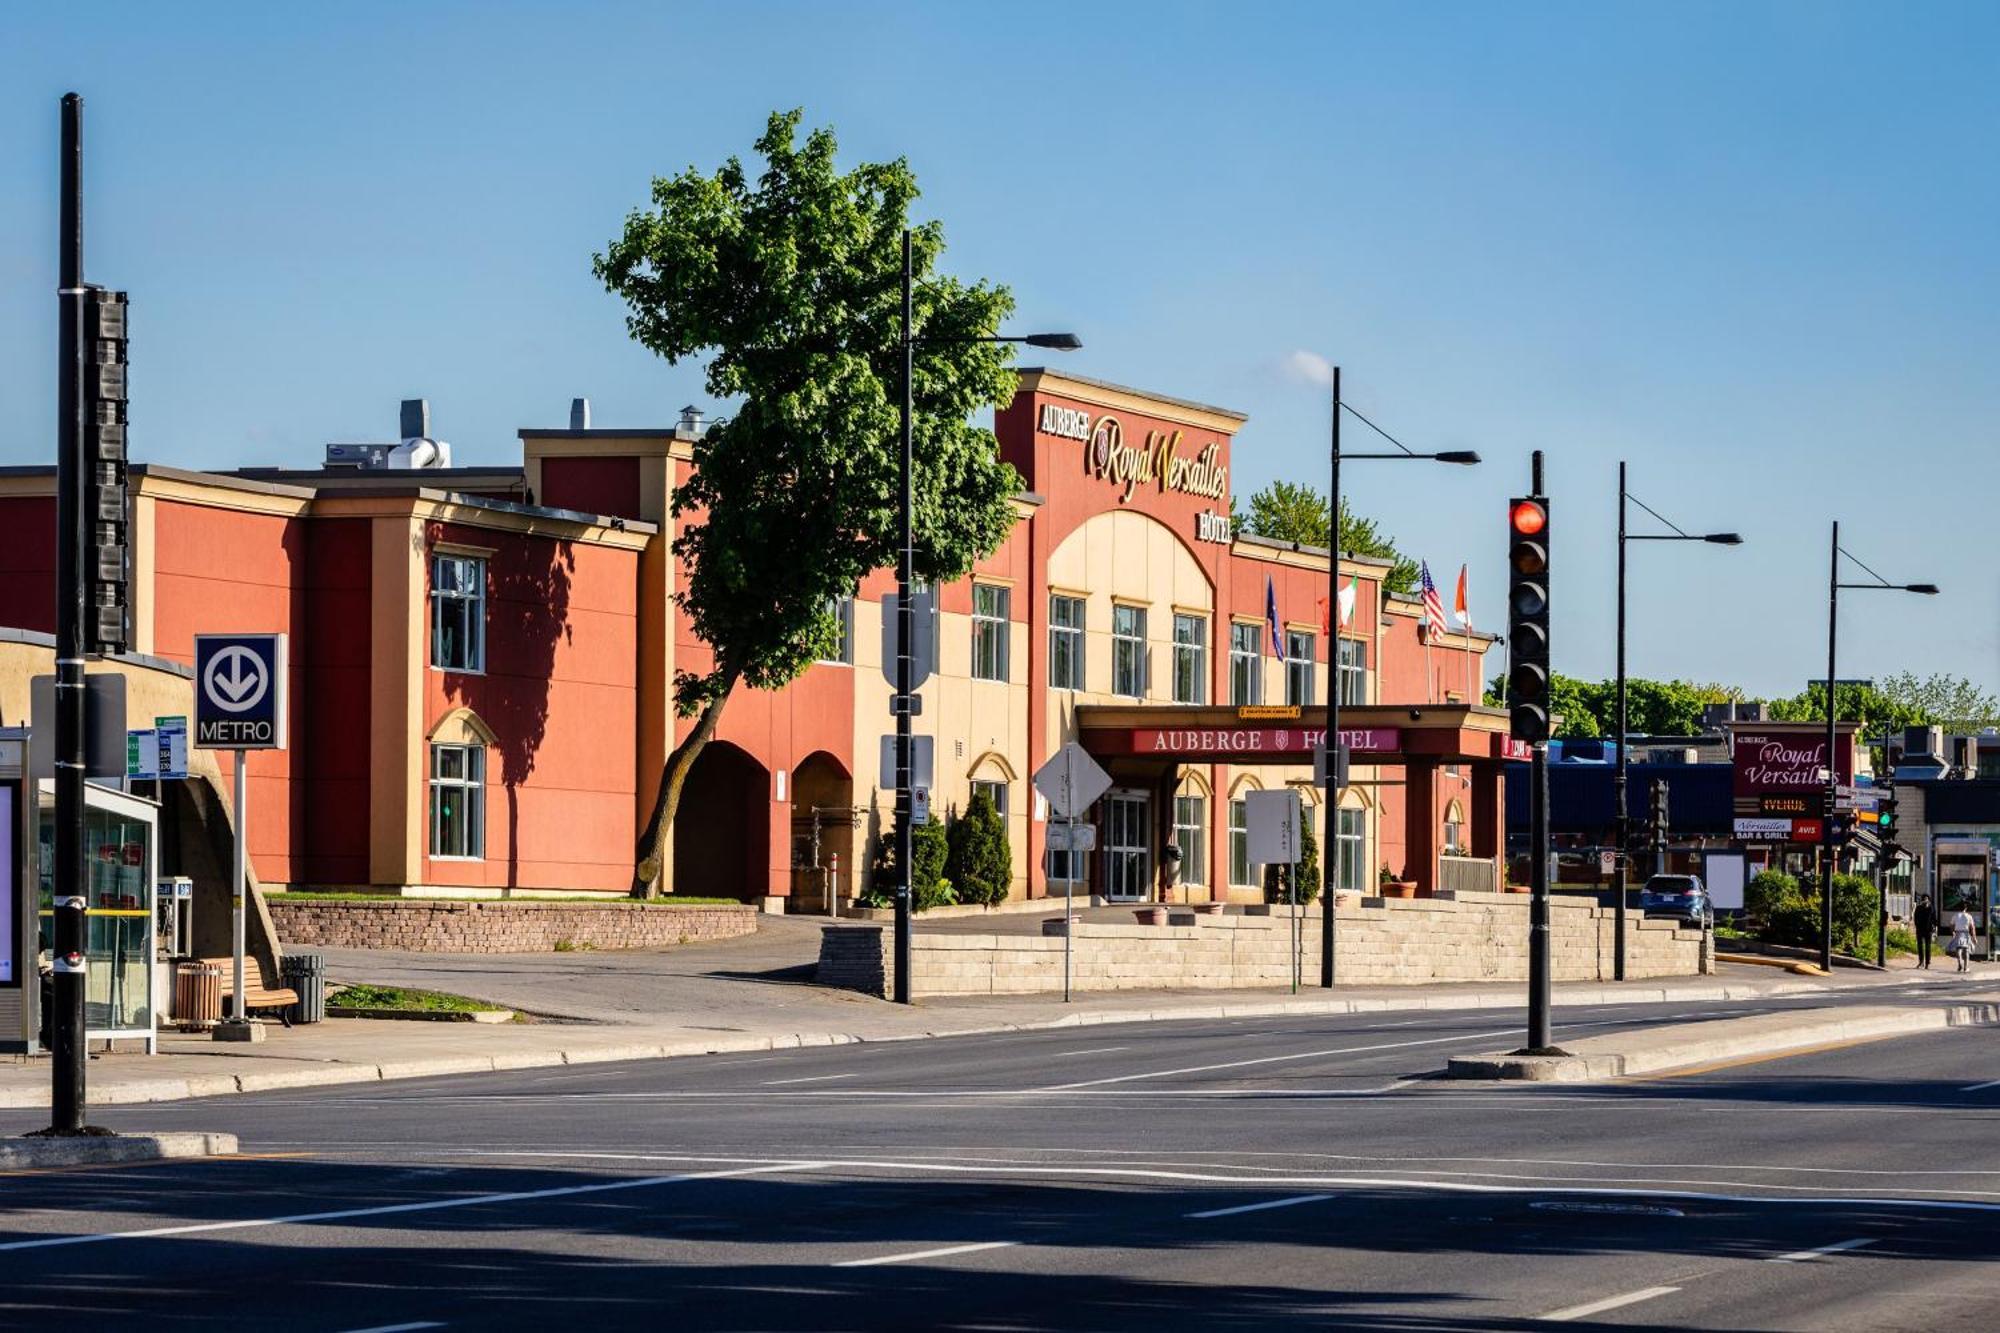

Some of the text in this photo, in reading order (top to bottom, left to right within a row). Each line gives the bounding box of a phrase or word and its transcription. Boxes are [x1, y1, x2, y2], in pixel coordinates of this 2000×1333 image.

[1041, 404, 1090, 440] AUBERGE
[1089, 415, 1227, 502] Royal Versailles
[1199, 509, 1233, 544] HÔTEL
[1154, 731, 1262, 751] AUBERGE
[1759, 742, 1826, 770] Royal
[1736, 832, 1790, 840] BAR & GRILL
